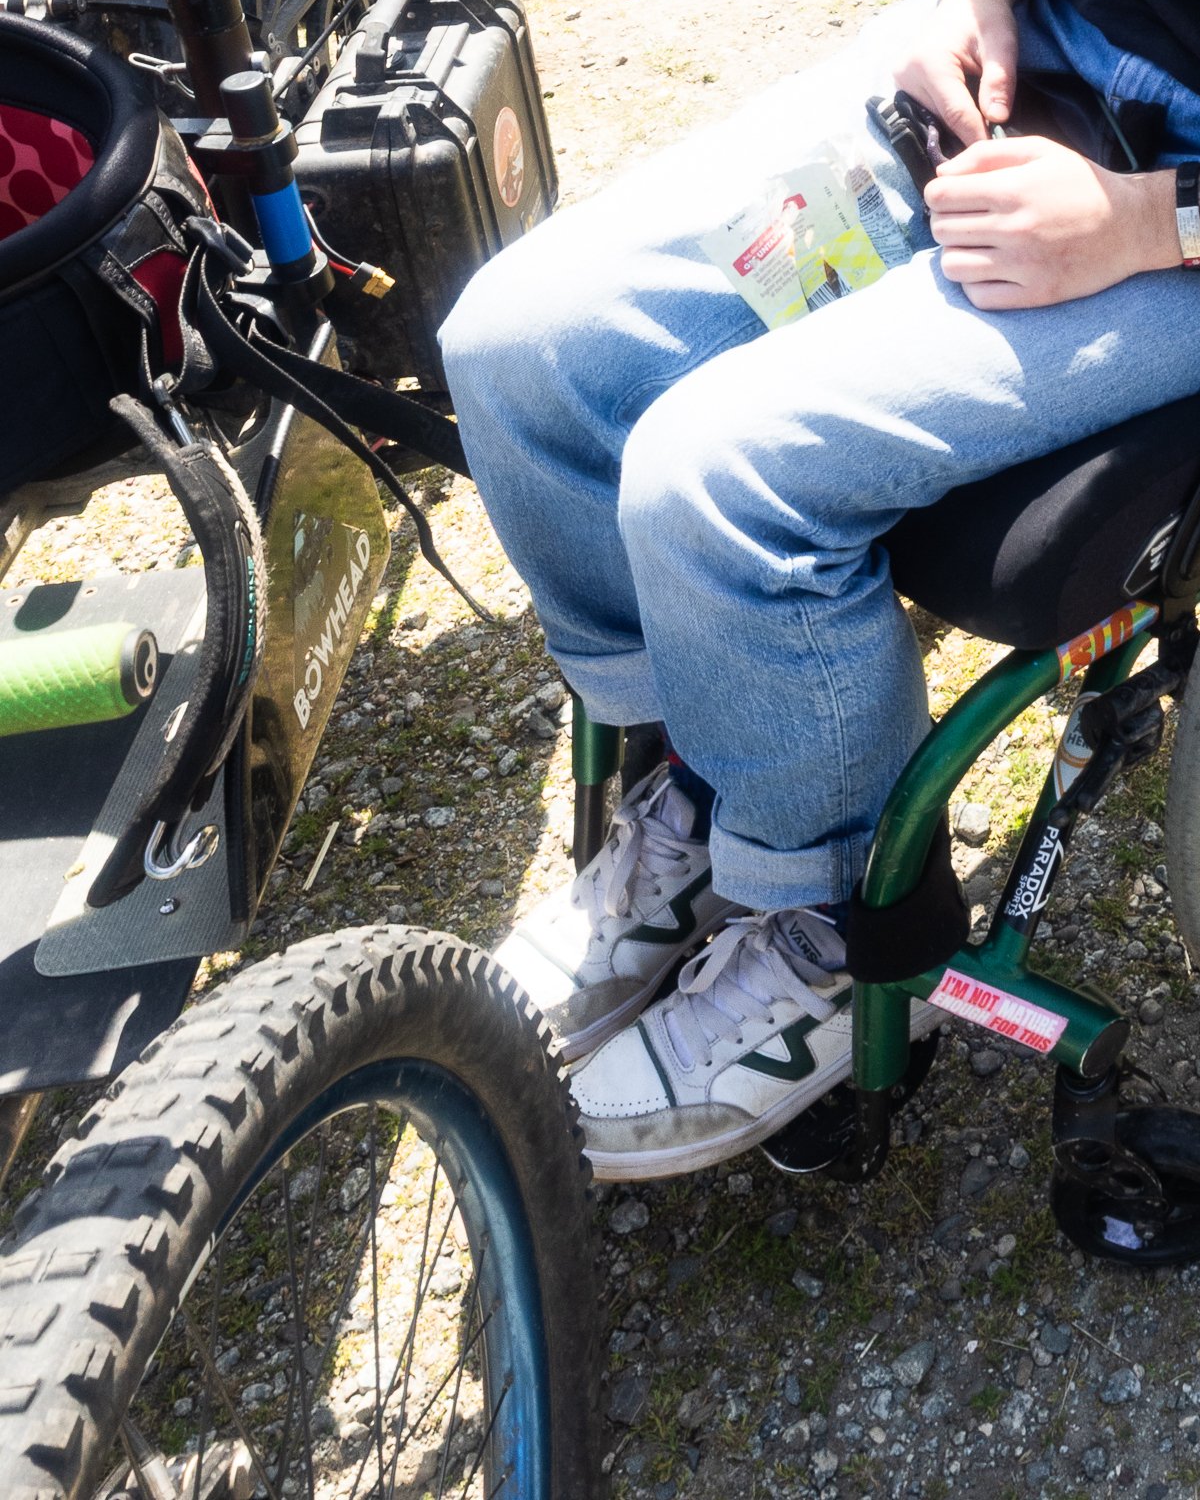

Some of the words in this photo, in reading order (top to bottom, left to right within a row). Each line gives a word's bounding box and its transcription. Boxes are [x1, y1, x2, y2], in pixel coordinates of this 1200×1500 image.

[294, 531, 370, 730] BOWHEAD
[1008, 874, 1027, 916] SPORTS
[1015, 826, 1060, 920] PARADOX
[789, 920, 822, 965] VANS
[935, 993, 992, 1021] ENOUGH
[988, 1016, 1020, 1037] FOR
[1020, 1029, 1052, 1051] THIS
[941, 976, 970, 999] I'M
[968, 987, 1000, 1012] NOT
[997, 1000, 1059, 1038] MATURE
